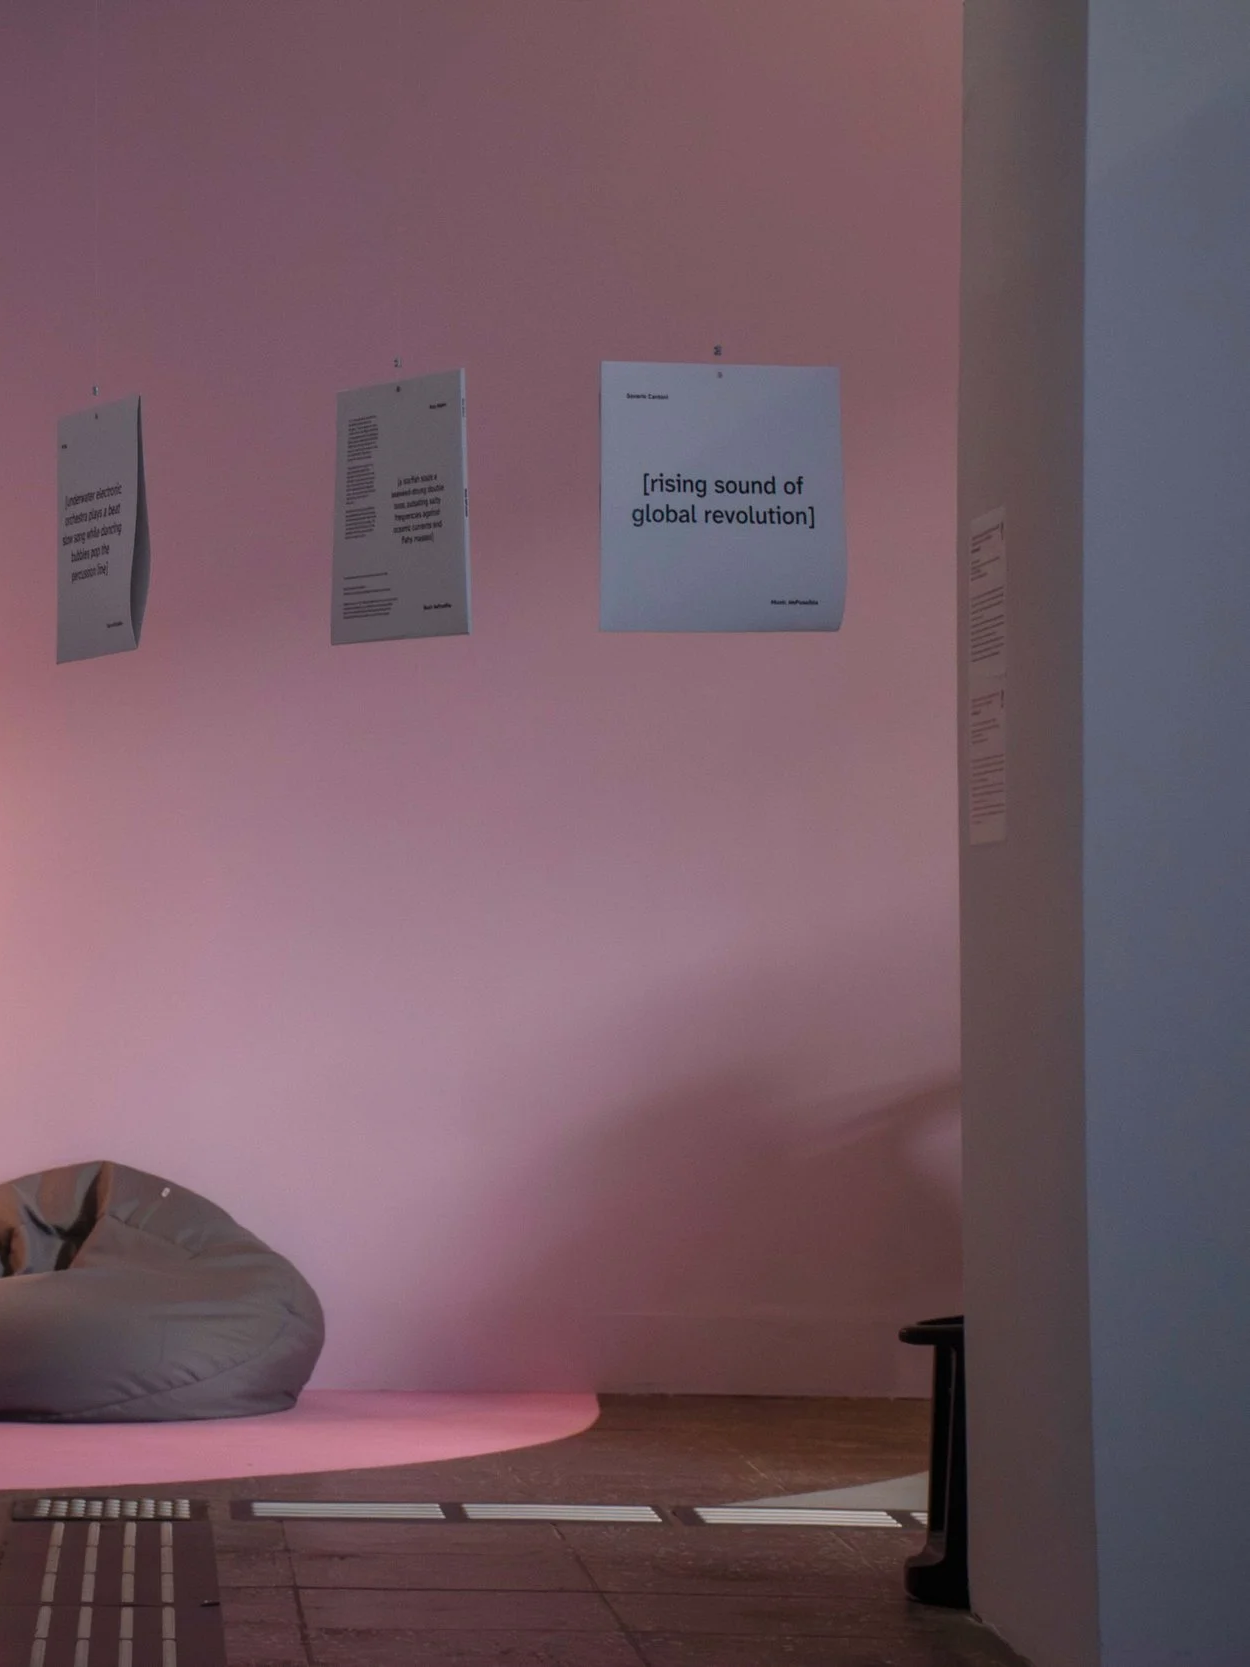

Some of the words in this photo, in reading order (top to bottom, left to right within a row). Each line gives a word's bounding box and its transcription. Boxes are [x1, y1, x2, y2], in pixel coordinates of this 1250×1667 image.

[643, 474, 707, 498] [rising
[714, 475, 776, 495] sound
[784, 476, 804, 496] of
[65, 511, 88, 527] orchestra
[631, 504, 697, 527] global
[704, 505, 815, 529] revolution]
[74, 532, 86, 545] song
[101, 542, 110, 555] the
